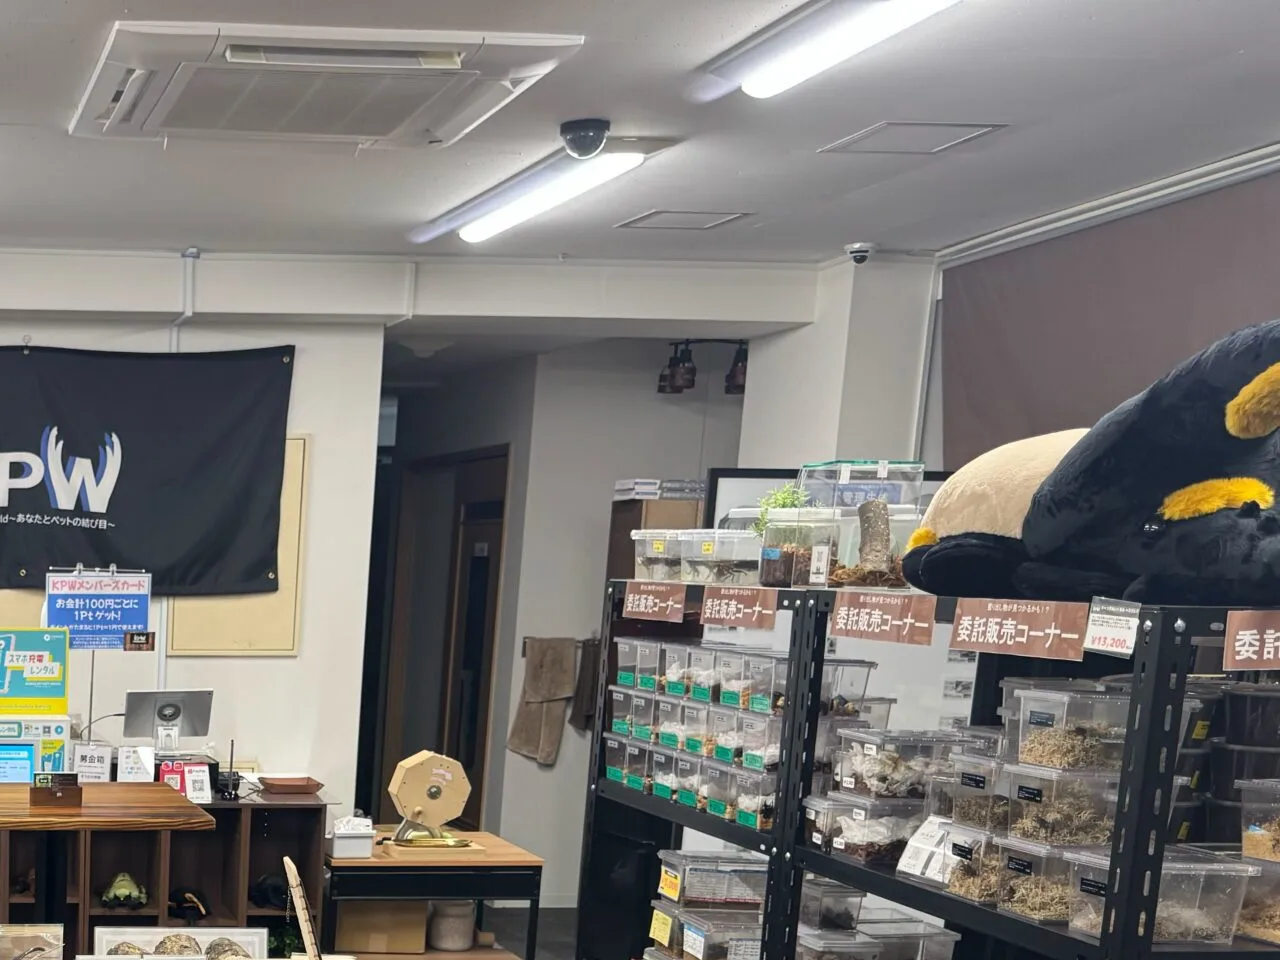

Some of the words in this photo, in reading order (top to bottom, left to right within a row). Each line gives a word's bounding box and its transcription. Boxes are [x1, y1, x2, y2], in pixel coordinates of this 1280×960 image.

[52, 580, 145, 591] KPWメンバーズカード
[56, 598, 138, 609] お会計100円ごとに
[626, 594, 682, 615] 委託販売コーナー
[704, 598, 774, 621] 委託販売コーナー
[836, 607, 929, 636] 委託販売コーナー
[957, 617, 1079, 648] 委託販売コーナー
[8, 654, 44, 664] スマホ充電
[29, 665, 55, 675] レンタル
